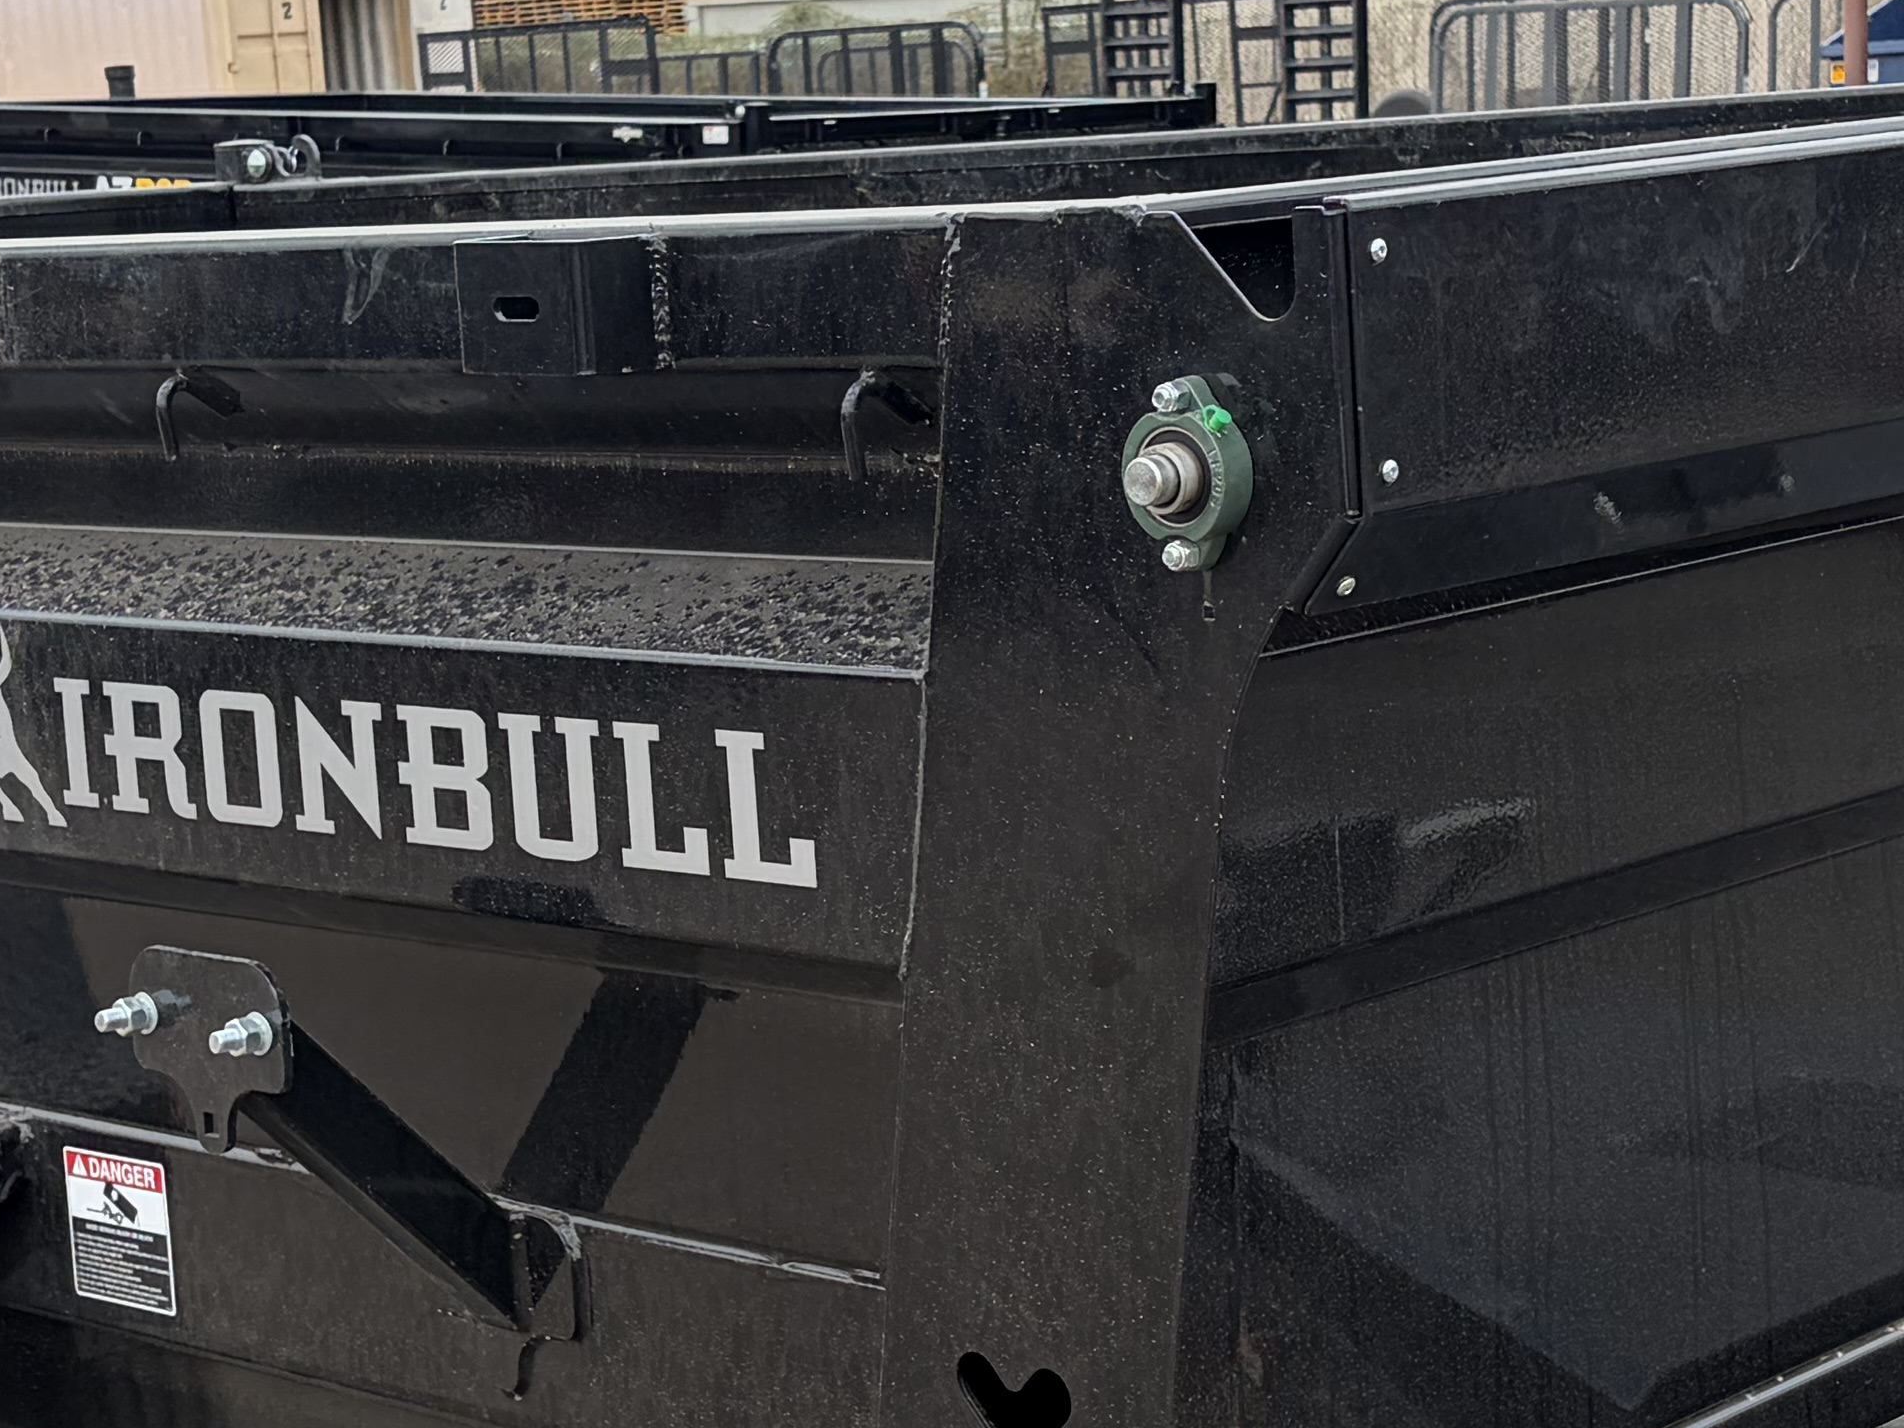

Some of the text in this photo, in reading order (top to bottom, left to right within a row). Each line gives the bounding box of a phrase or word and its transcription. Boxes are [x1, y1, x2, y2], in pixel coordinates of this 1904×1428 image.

[281, 1, 293, 20] 2
[53, 677, 817, 889] IRONBULL
[87, 1157, 157, 1190] DANGER
